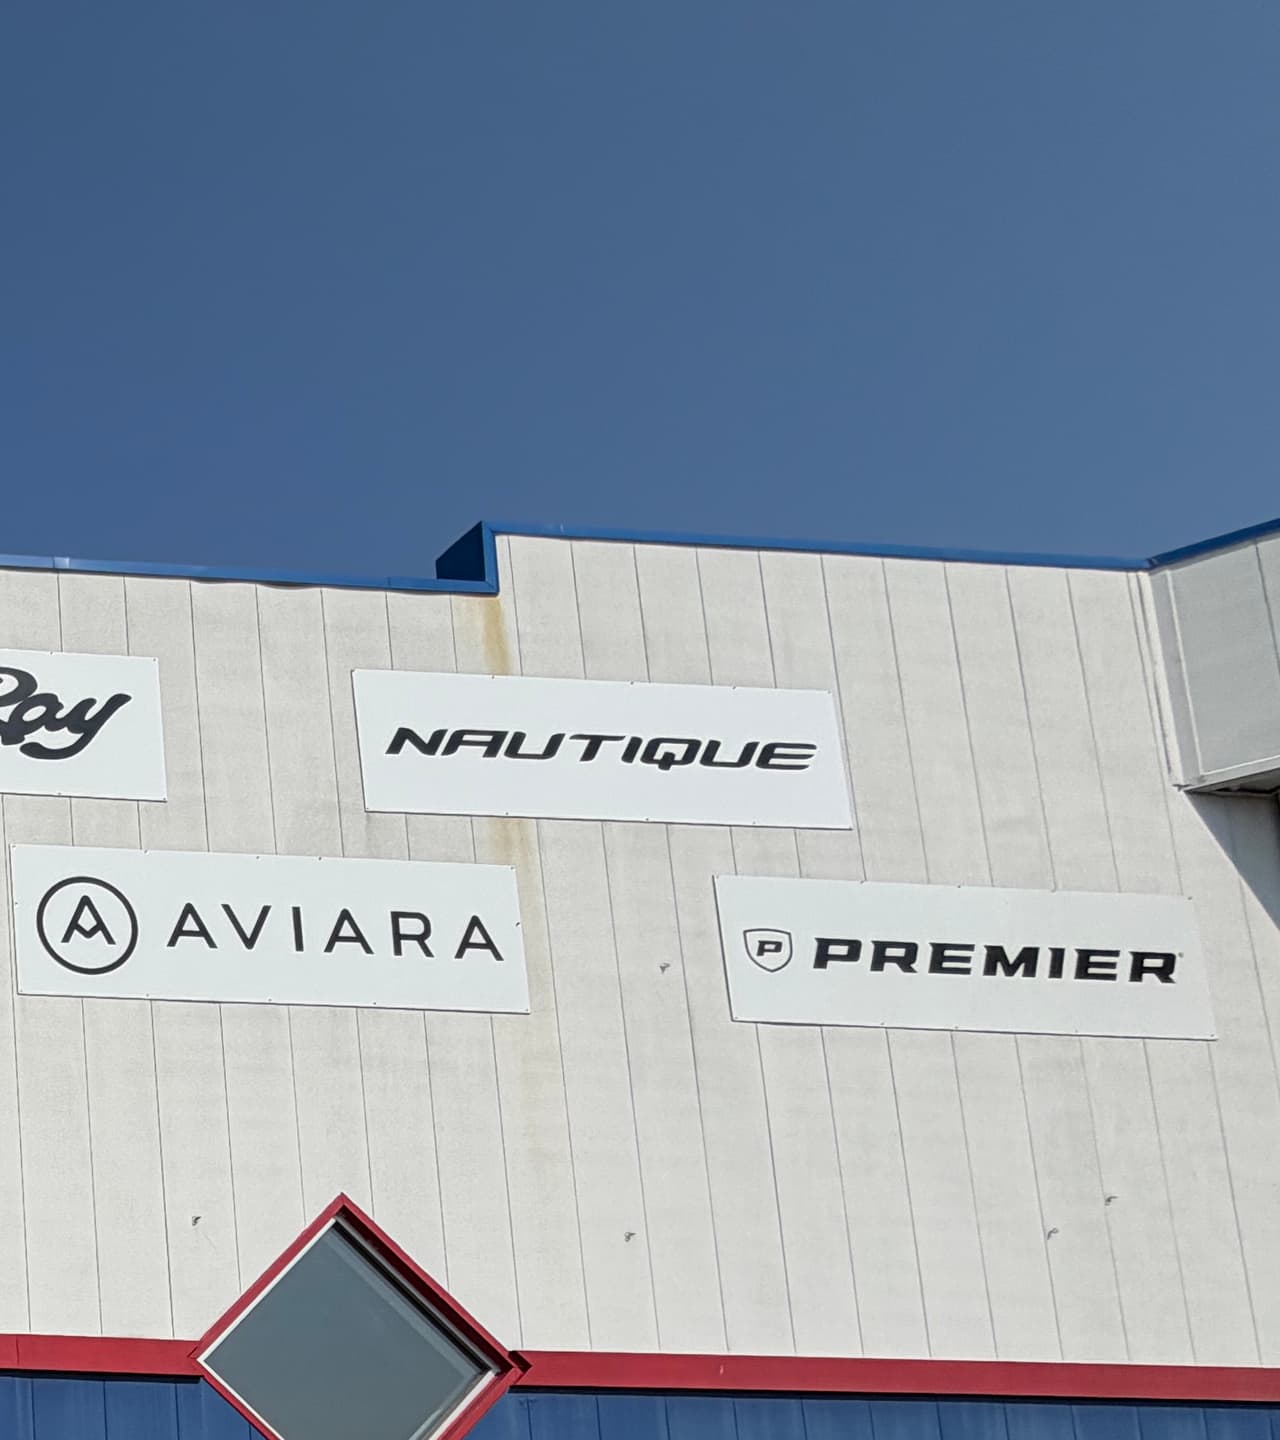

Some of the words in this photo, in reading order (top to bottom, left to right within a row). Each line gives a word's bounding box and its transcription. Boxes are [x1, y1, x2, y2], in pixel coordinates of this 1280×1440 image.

[385, 727, 817, 771] NAUTIQUE
[166, 902, 504, 962] AVIARA
[813, 937, 1177, 984] PREMIER
